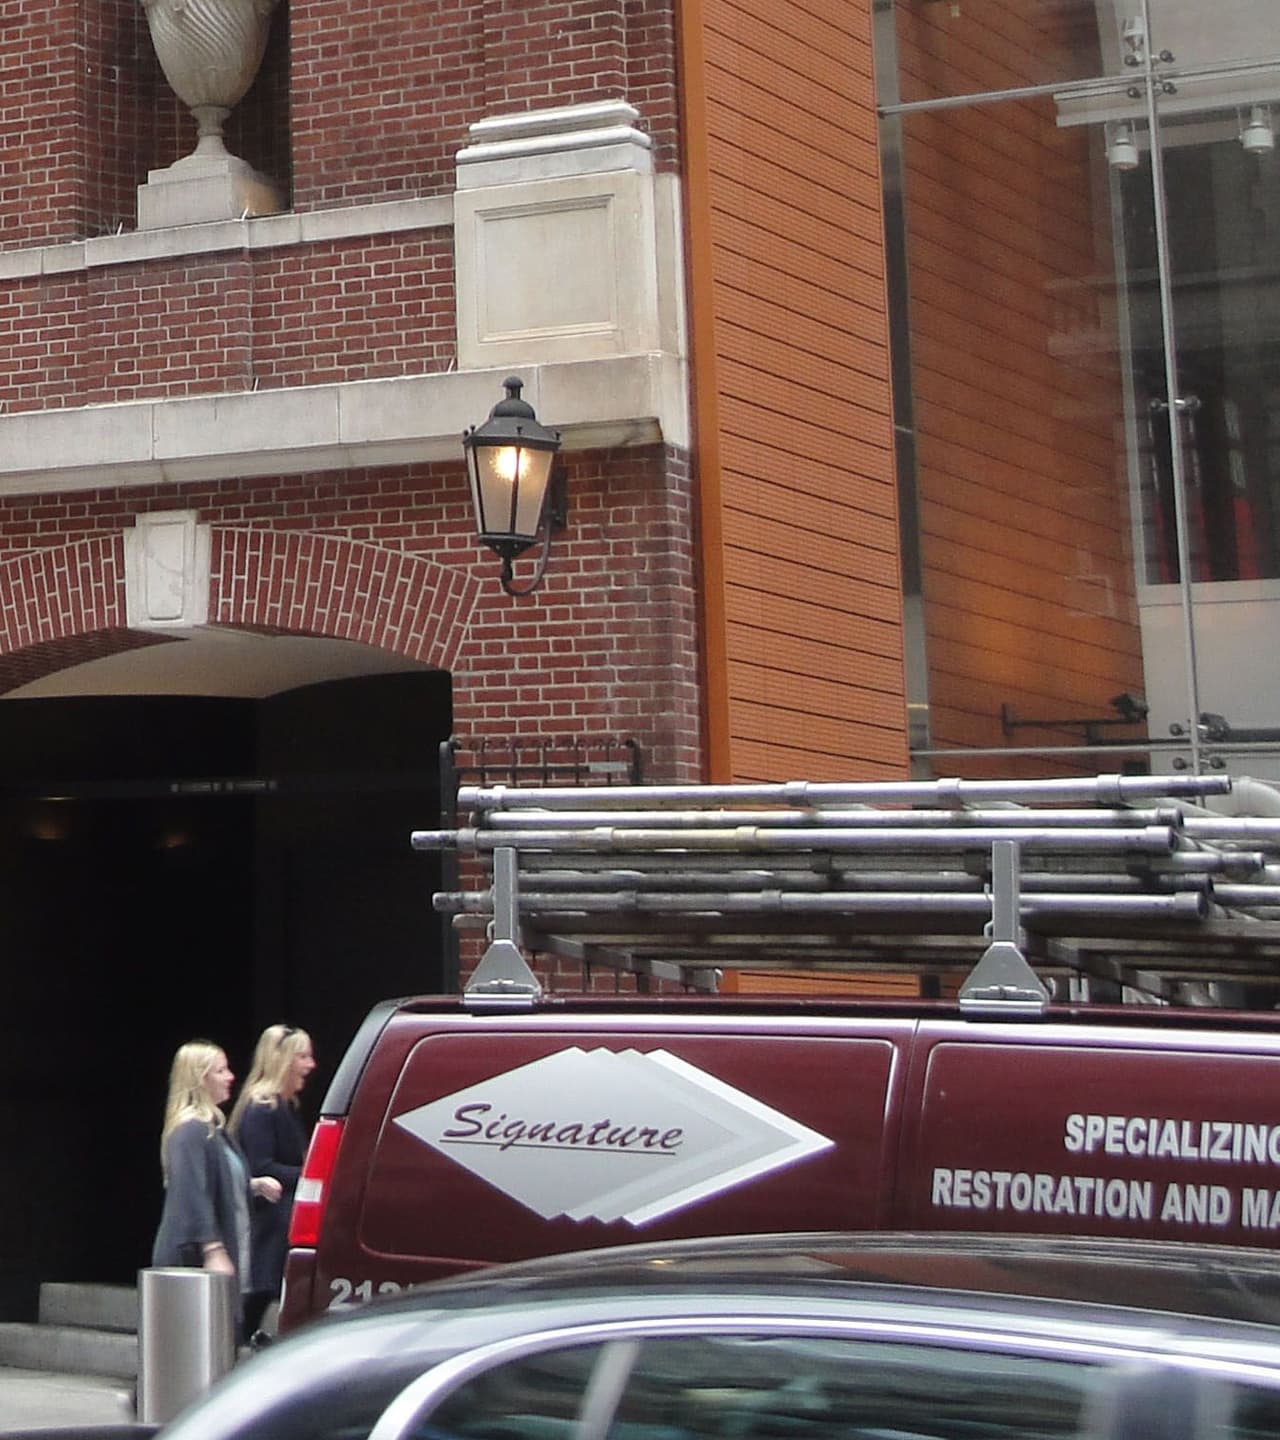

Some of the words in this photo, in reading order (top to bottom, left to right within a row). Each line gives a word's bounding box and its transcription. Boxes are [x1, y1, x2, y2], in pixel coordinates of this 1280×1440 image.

[443, 1103, 684, 1151] Signature
[931, 1168, 1152, 1220] RESTORATION
[1160, 1183, 1231, 1225] AND
